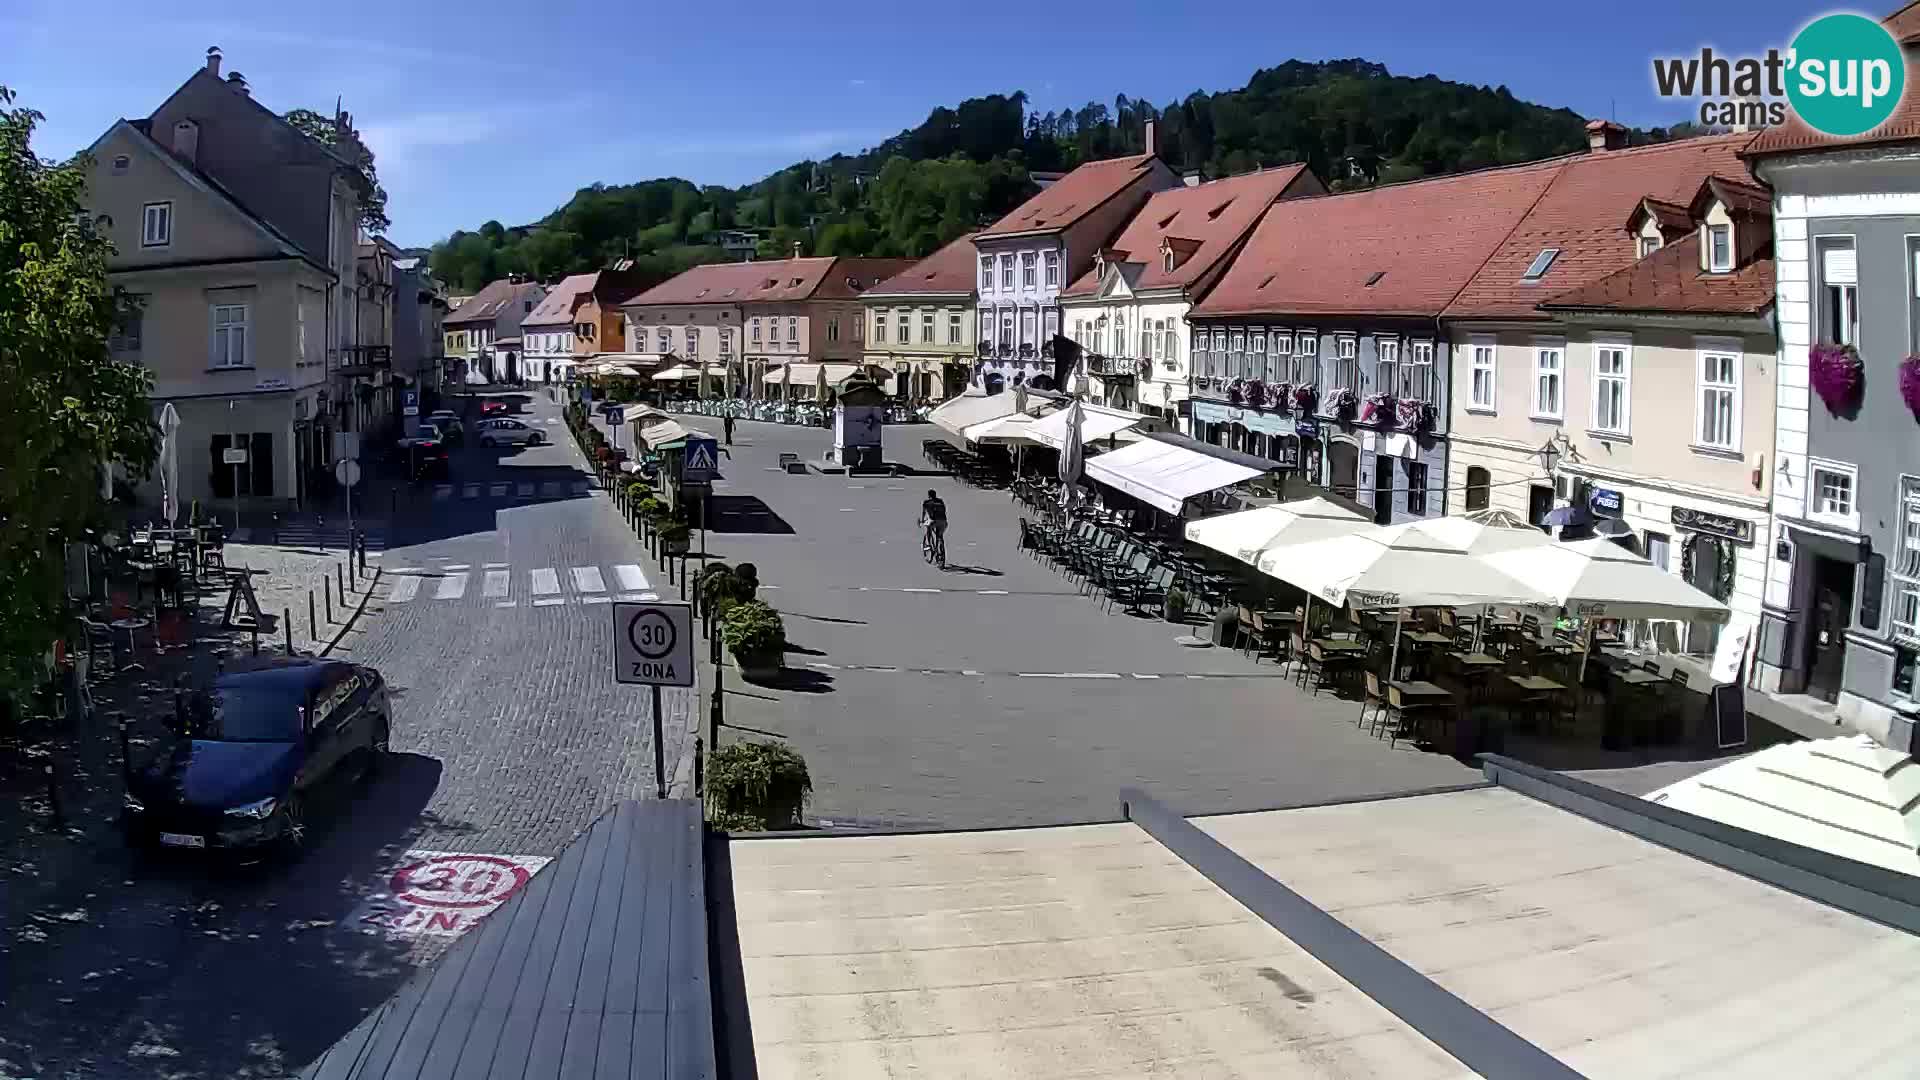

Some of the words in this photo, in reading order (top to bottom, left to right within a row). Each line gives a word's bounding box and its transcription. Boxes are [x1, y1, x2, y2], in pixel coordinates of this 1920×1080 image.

[407, 393, 415, 405] P
[640, 624, 666, 646] 30
[631, 662, 677, 680] ZONA
[408, 867, 502, 896] 30
